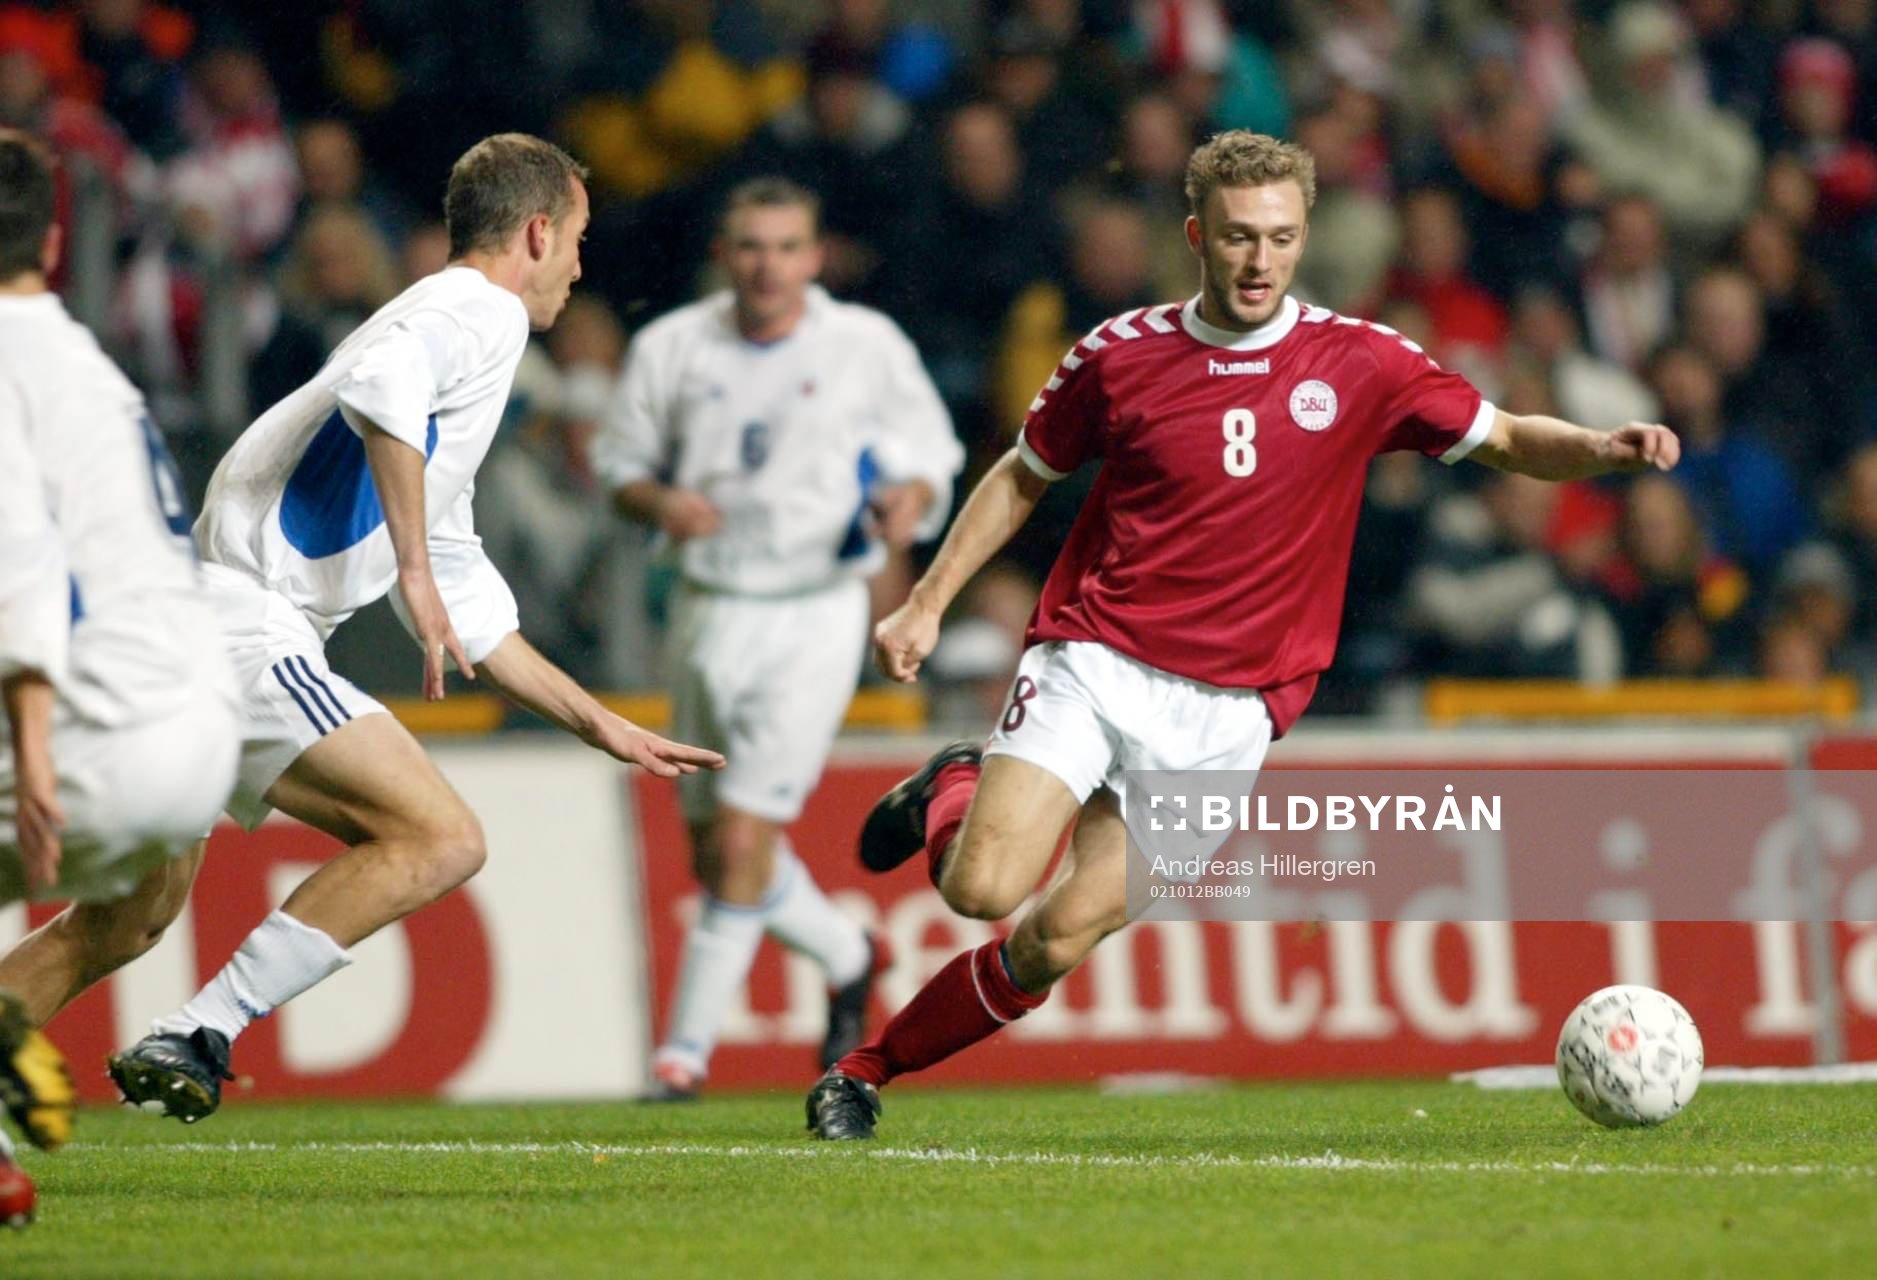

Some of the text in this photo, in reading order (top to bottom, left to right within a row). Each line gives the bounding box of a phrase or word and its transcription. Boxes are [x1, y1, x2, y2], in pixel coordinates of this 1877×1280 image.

[1209, 358, 1270, 375] hummel
[1223, 408, 1257, 477] 8
[1002, 675, 1037, 731] 8
[673, 815, 1540, 1043] remtid
